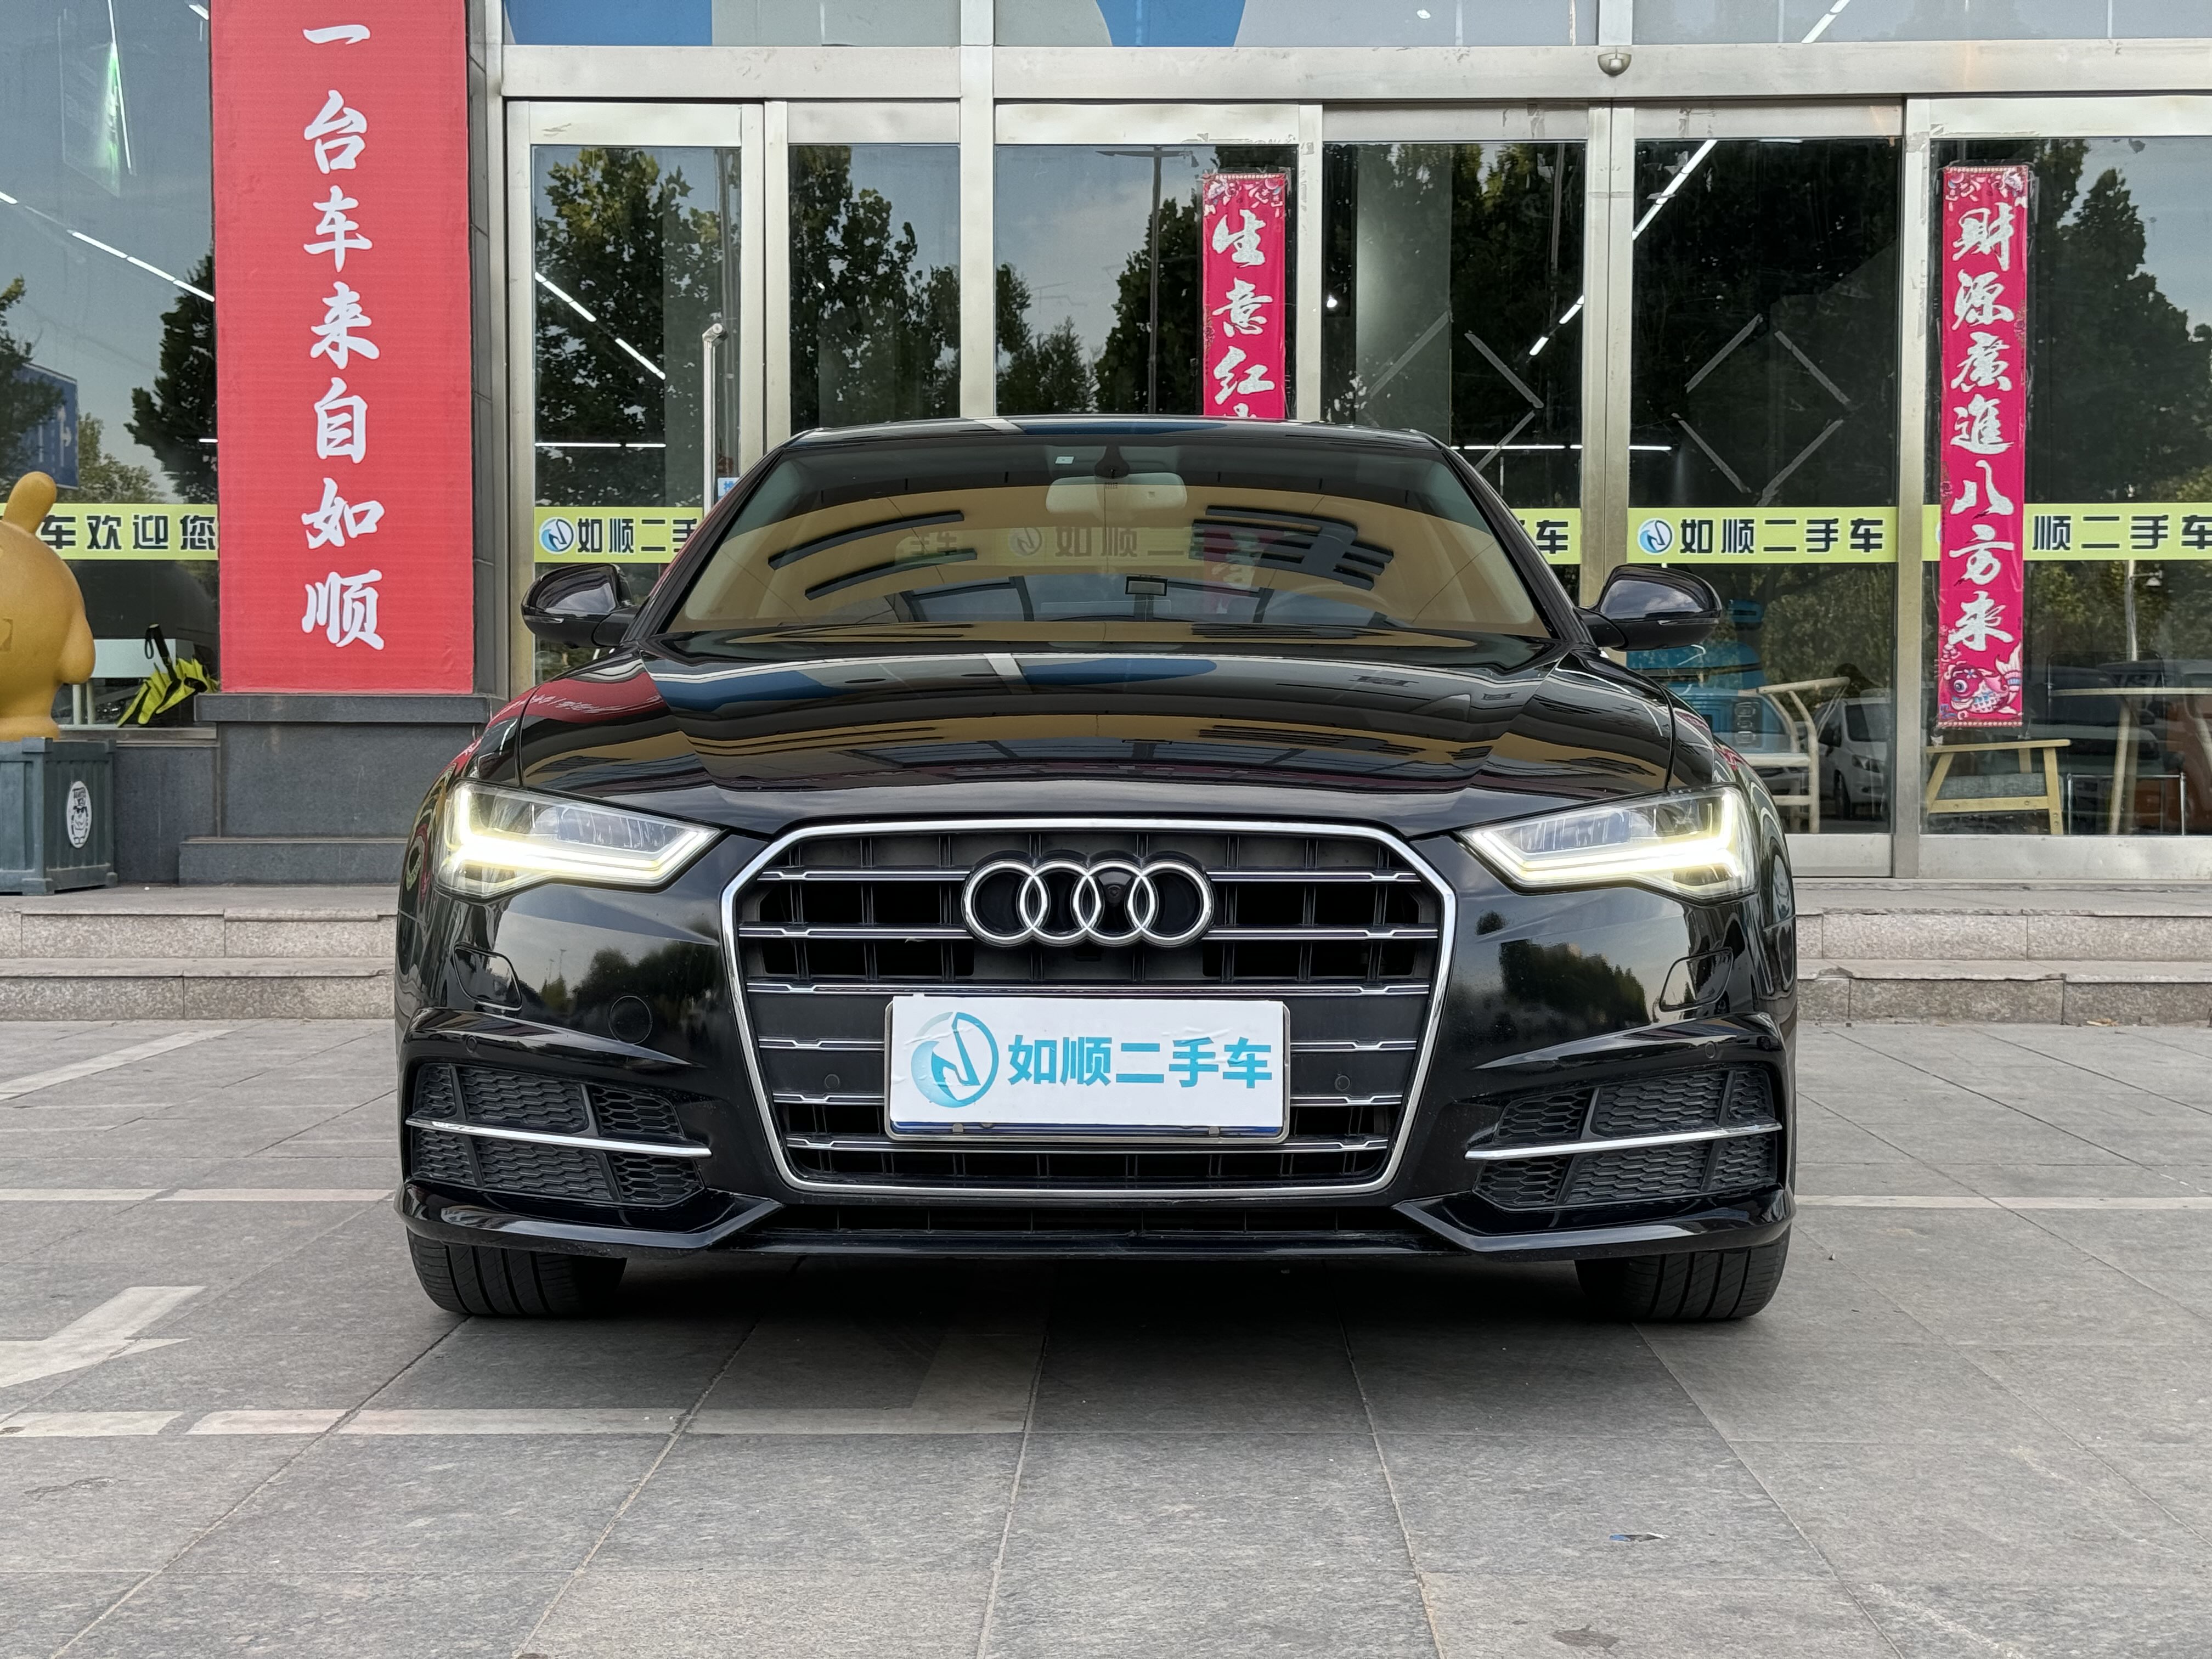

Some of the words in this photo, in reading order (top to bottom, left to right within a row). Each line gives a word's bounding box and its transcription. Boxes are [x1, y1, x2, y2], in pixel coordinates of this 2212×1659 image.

[301, 24, 386, 651] 一台车来自如顺
[1212, 209, 1276, 417] 生意红
[1679, 518, 1883, 553] 如顺二手车
[2033, 515, 2212, 550] 顺二手车
[1008, 1035, 1272, 1088] 如顺二手车
